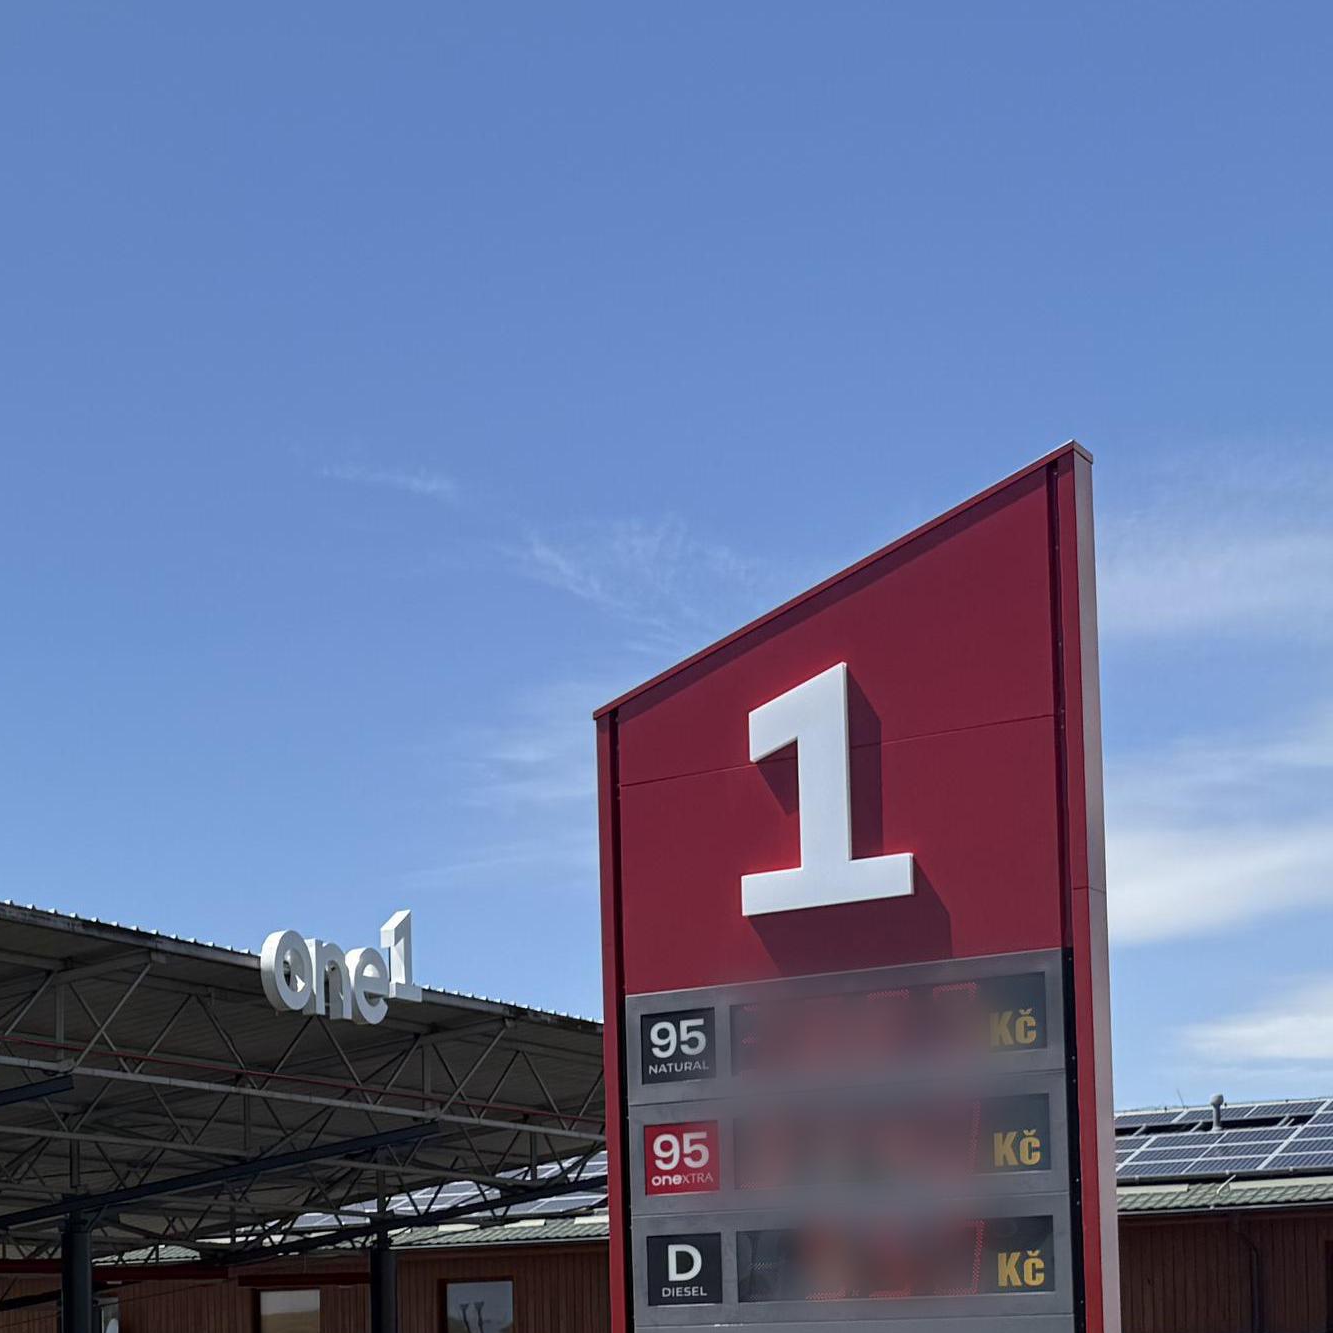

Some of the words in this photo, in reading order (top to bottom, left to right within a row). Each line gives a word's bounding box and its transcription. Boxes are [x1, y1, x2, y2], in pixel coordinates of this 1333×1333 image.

[741, 661, 914, 917] 1
[650, 1018, 707, 1058] 95
[989, 1007, 1038, 1047] Kč
[648, 1060, 710, 1075] NATURAL
[653, 1131, 710, 1171] 95
[993, 1128, 1041, 1167] Kč
[668, 1244, 702, 1282] D
[997, 1250, 1045, 1288] Kč
[661, 1286, 708, 1298] DIESEL
